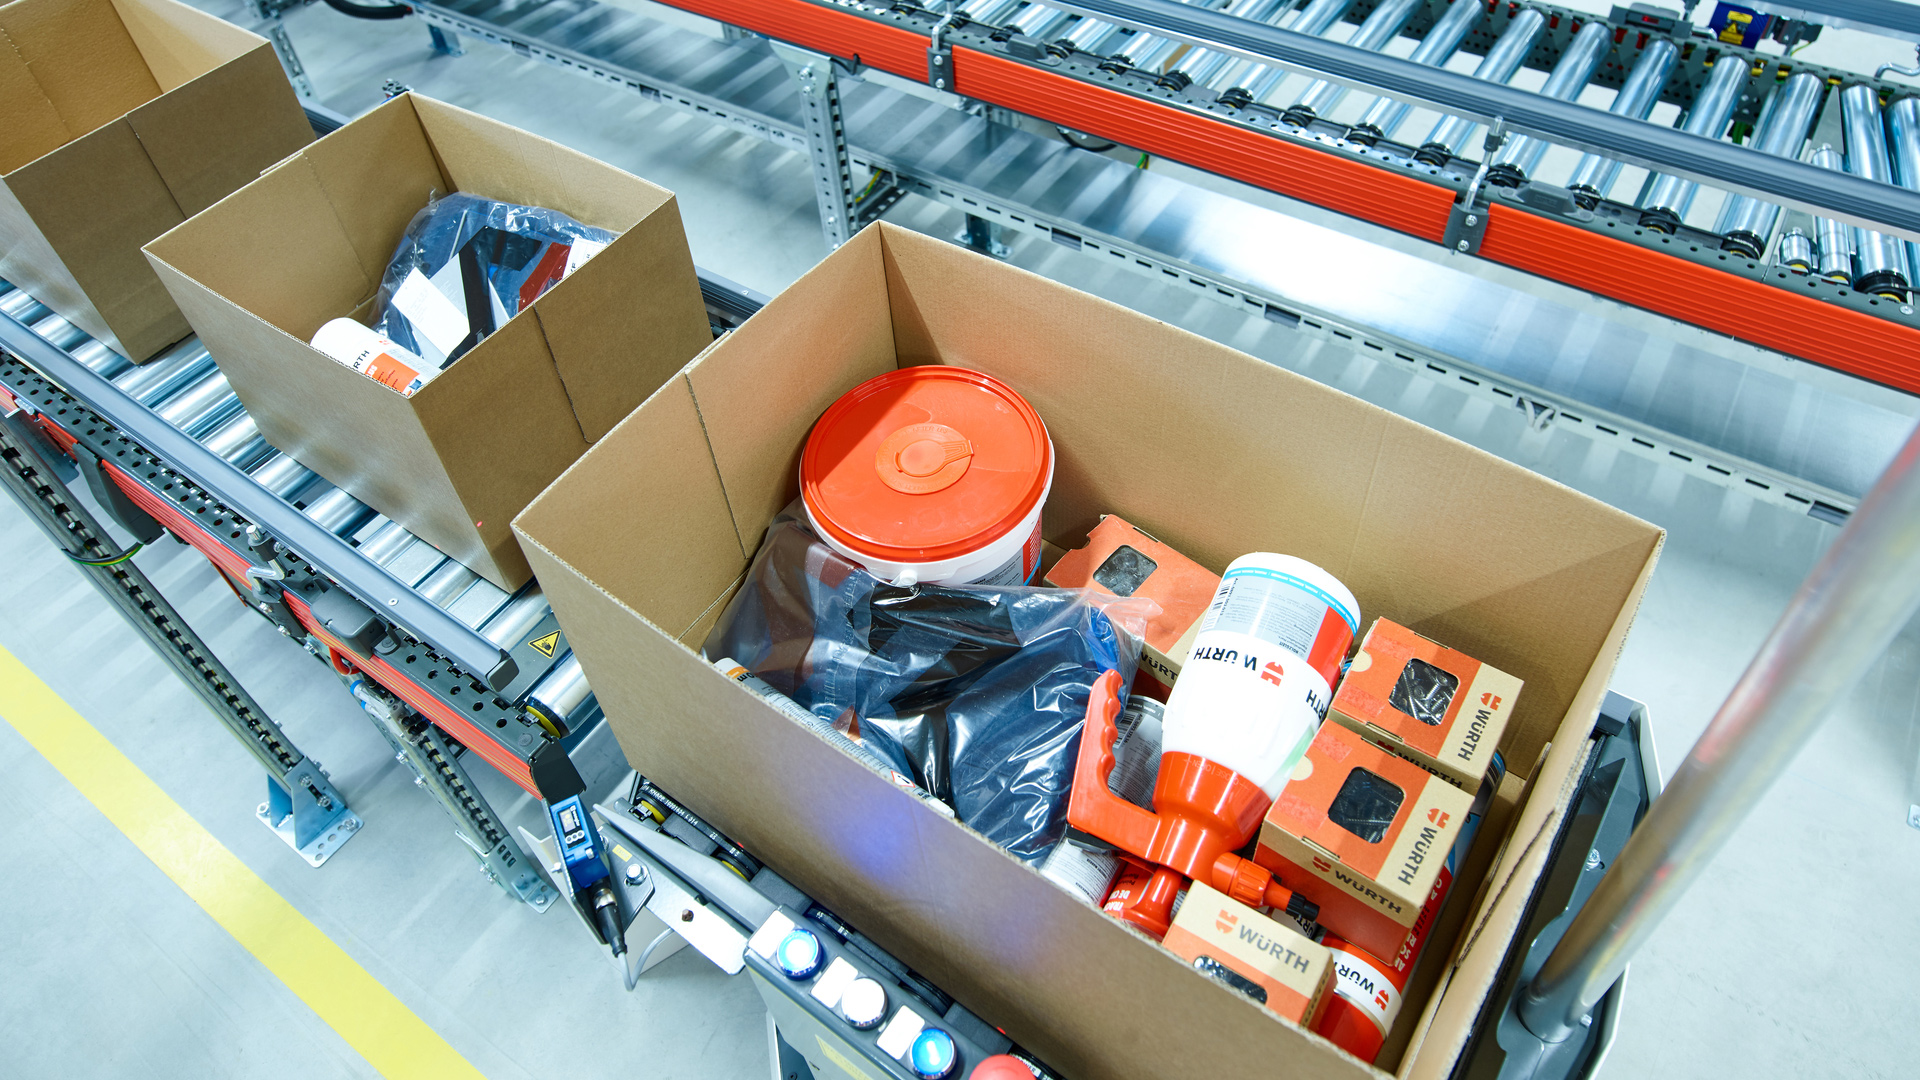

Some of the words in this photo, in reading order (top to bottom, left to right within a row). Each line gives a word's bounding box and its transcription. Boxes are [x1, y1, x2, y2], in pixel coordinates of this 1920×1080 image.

[352, 350, 370, 369] RTH
[1140, 651, 1178, 681] WÜRT
[1193, 646, 1259, 671] WÜRTH
[1305, 689, 1329, 720] RTH
[1457, 709, 1493, 761] WÜRTH
[1397, 826, 1439, 886] WÜRTH
[1335, 870, 1402, 914] WÜRTH
[1239, 925, 1310, 974] WÜRTH
